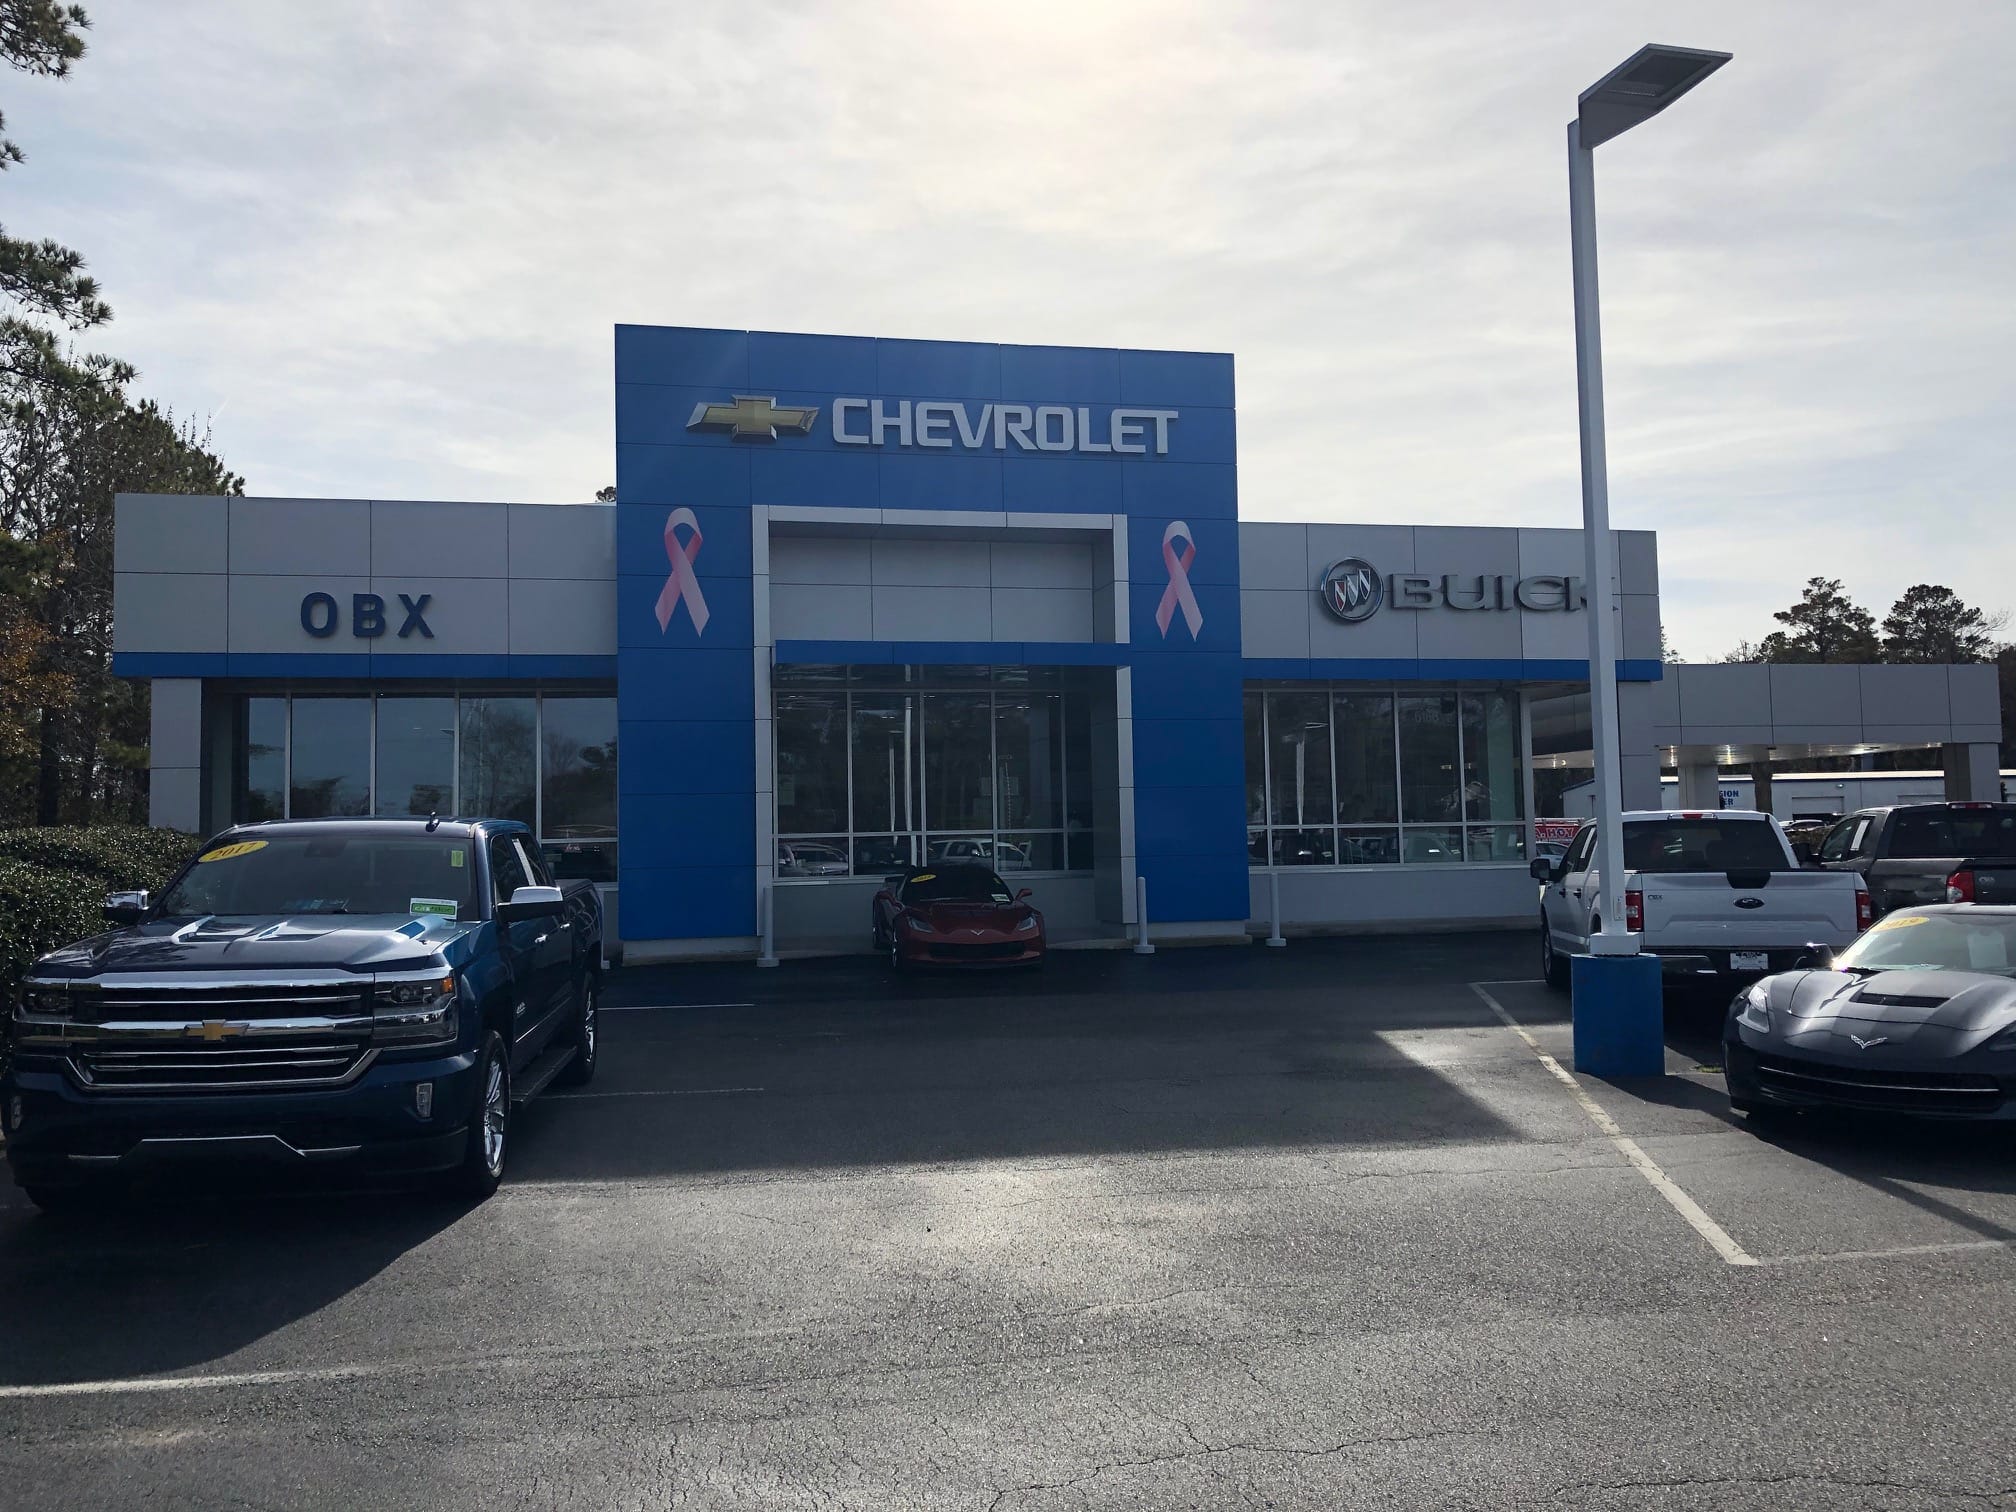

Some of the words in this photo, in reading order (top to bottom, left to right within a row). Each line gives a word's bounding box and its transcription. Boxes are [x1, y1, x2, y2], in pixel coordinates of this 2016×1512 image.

[832, 397, 1180, 455] CHEVROLET
[301, 592, 435, 638] OBX
[209, 842, 258, 860] 2017
